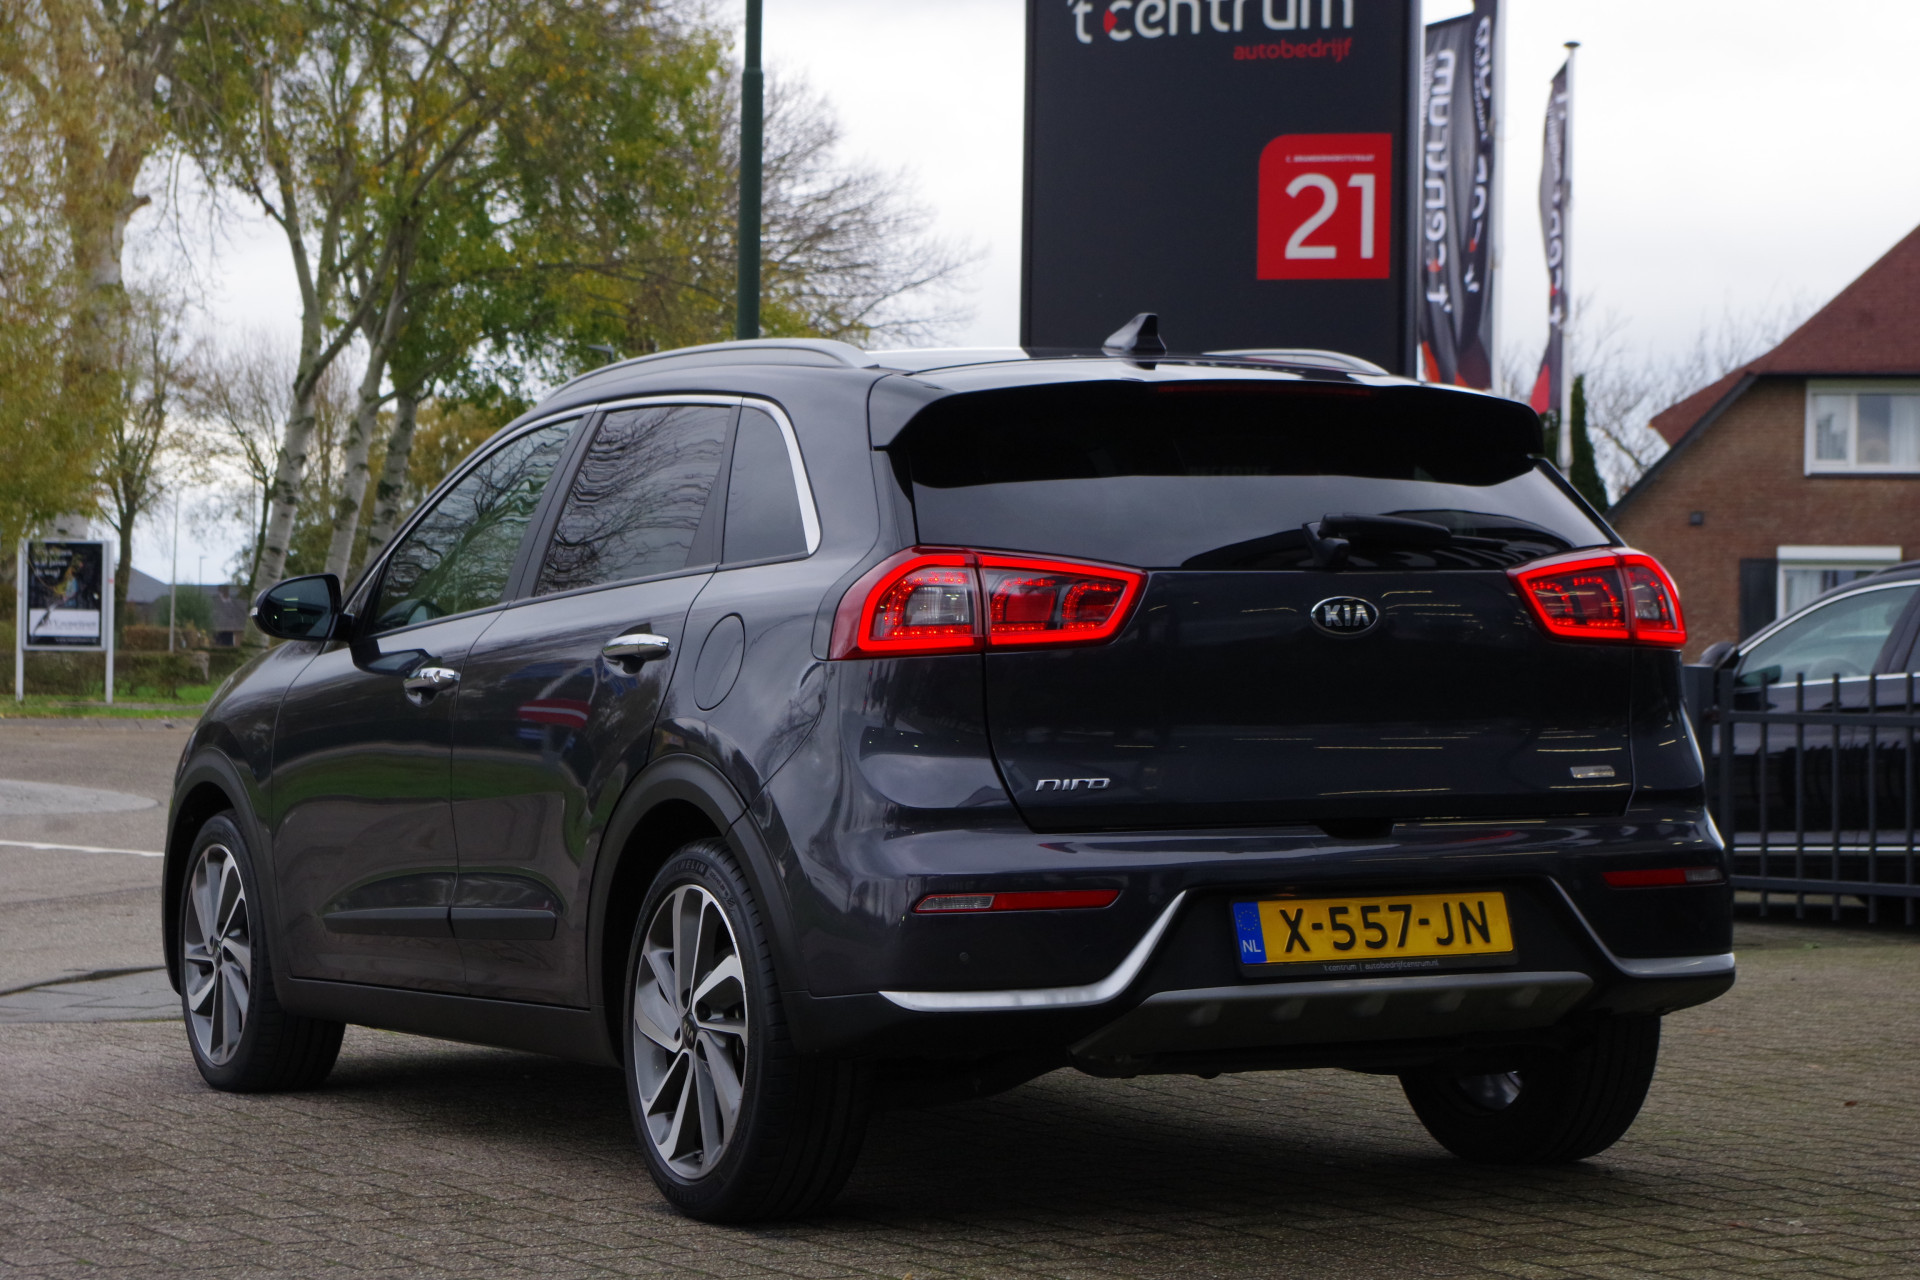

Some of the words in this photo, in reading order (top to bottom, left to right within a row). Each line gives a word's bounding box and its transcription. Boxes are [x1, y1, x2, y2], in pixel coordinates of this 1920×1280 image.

[1103, 0, 1354, 41] centrum
[1233, 37, 1352, 62] autobedrijf
[1285, 172, 1375, 260] 21
[1323, 604, 1370, 626] KIA
[1279, 901, 1491, 953] X-557-JN
[1242, 939, 1262, 953] NL
